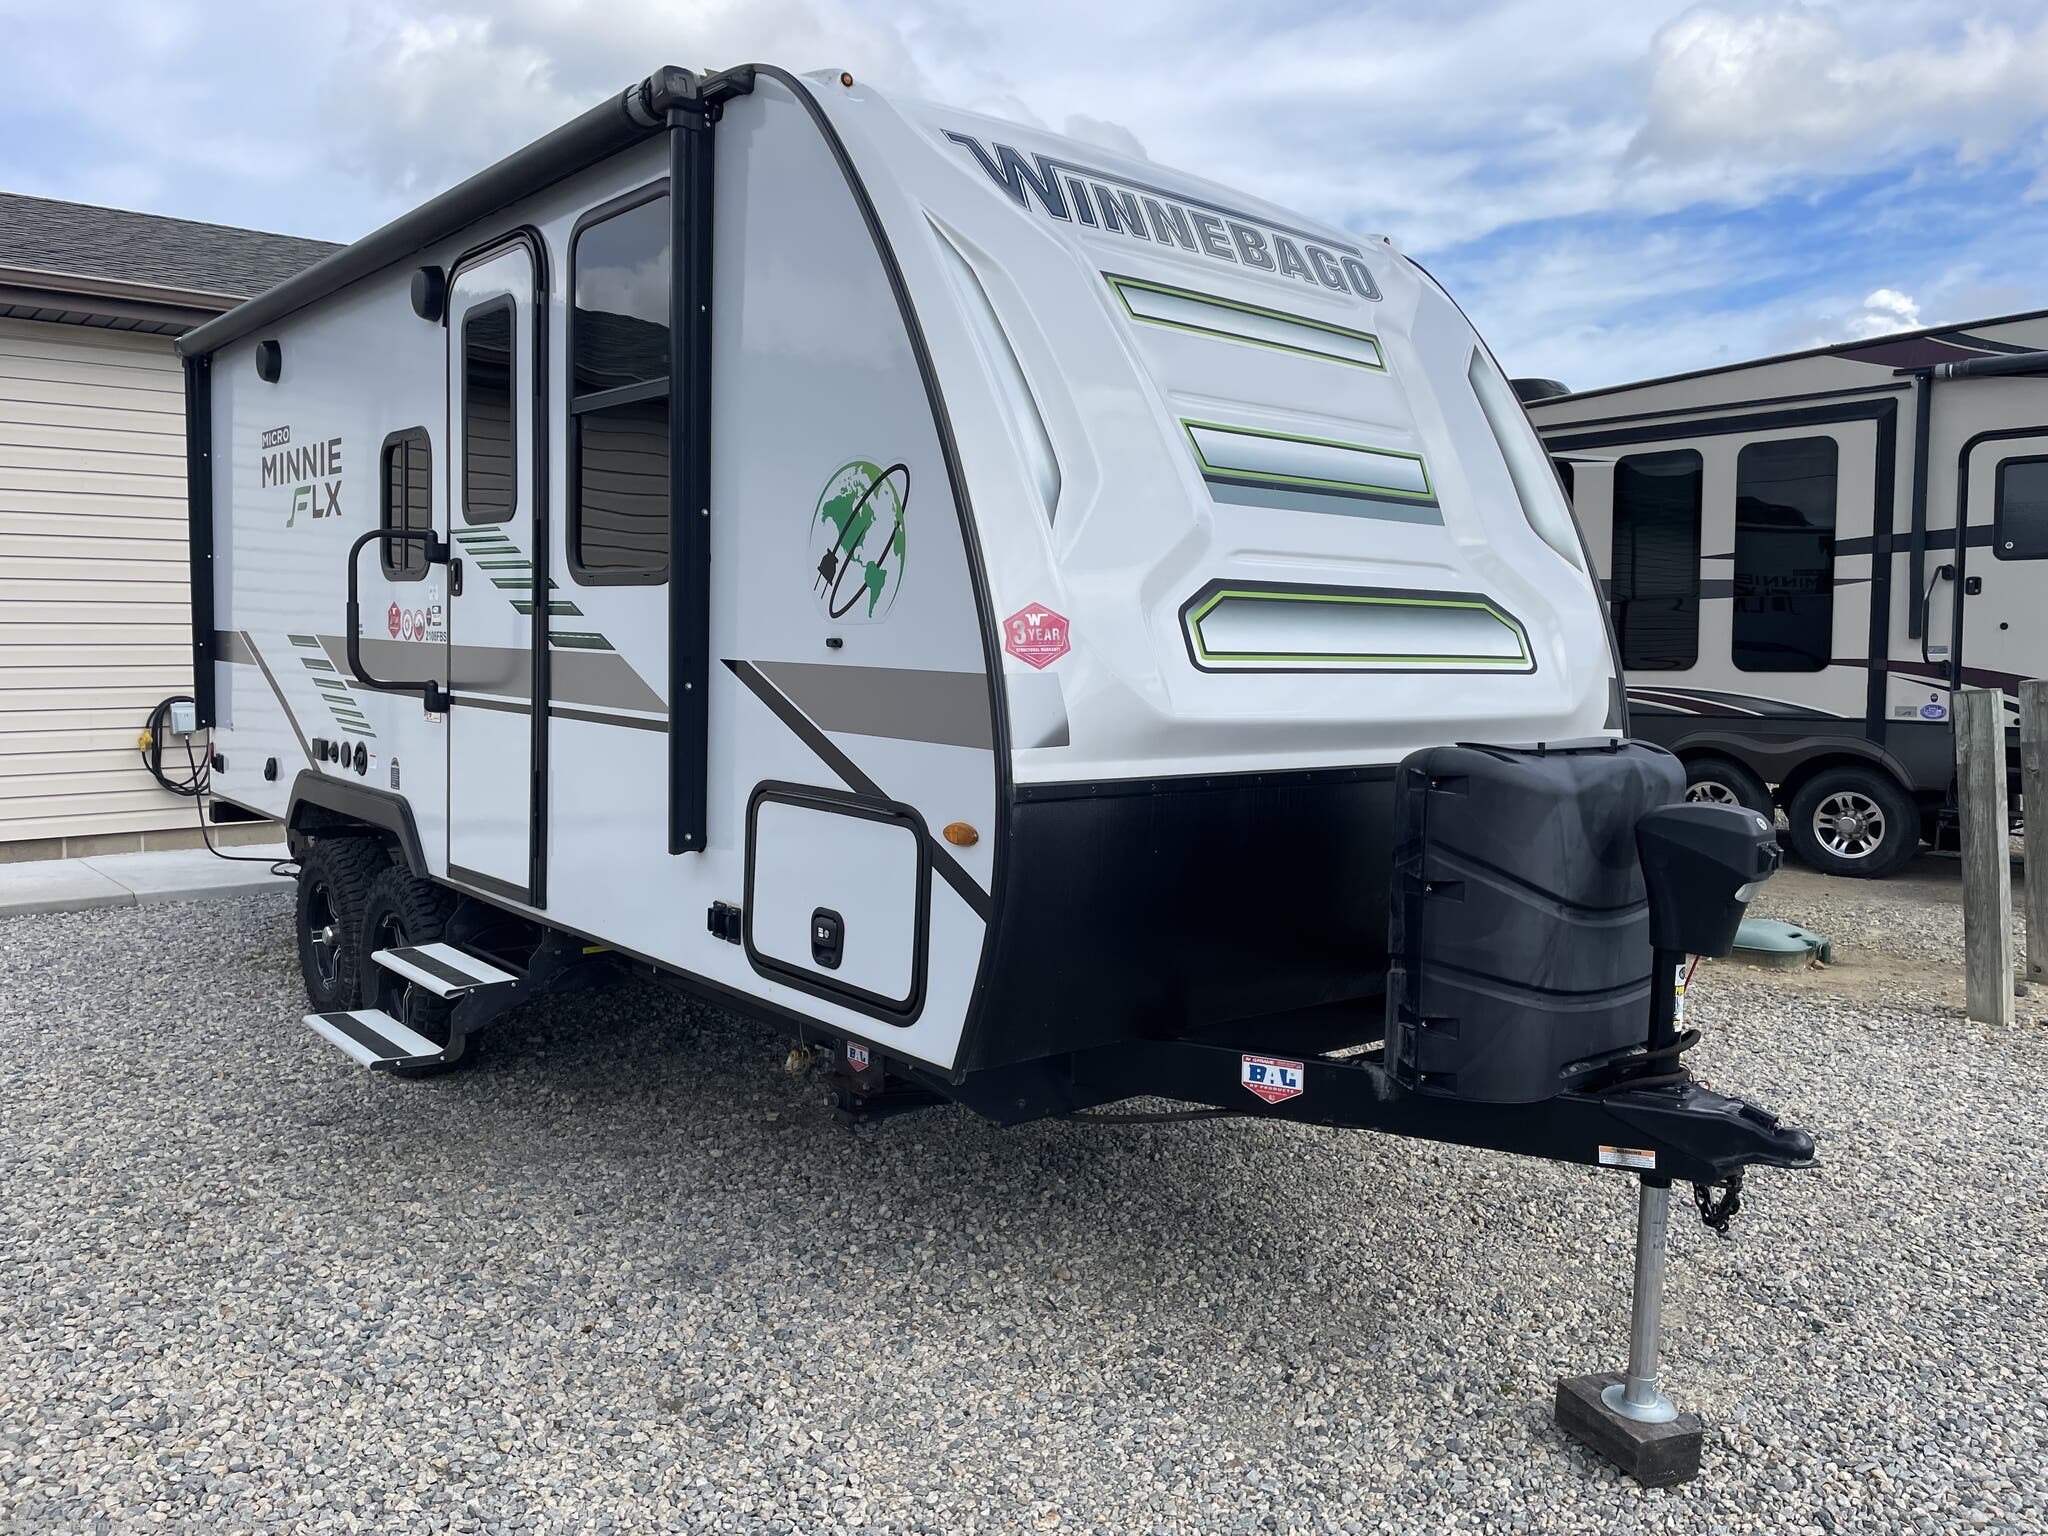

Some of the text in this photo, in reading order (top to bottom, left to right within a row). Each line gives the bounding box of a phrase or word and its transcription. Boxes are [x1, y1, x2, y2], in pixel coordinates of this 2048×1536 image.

[939, 128, 1384, 302] WINNEBAGO
[262, 428, 289, 448] MICRO
[262, 437, 342, 488] MINNIE
[286, 480, 342, 528] FLX
[1012, 620, 1060, 645] 3 YEAR
